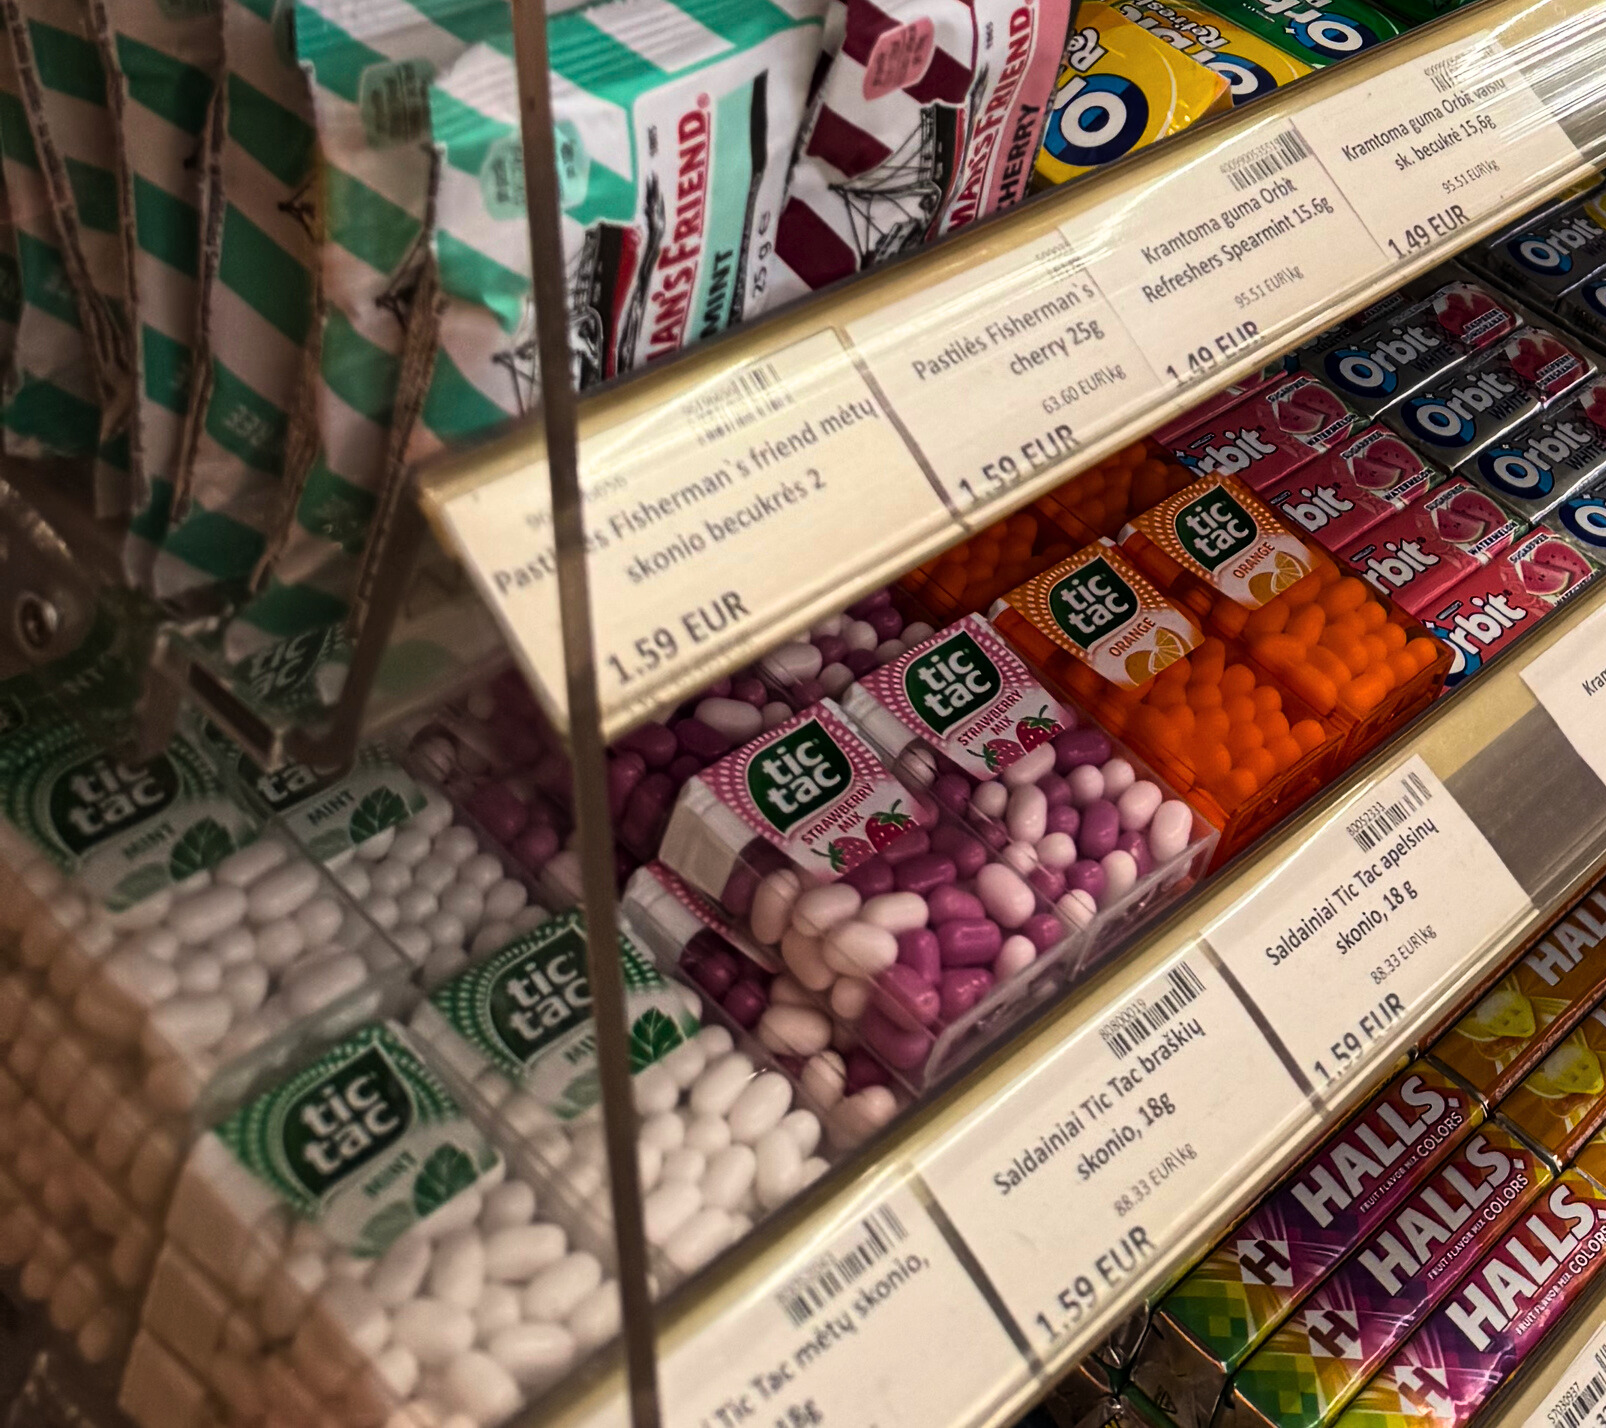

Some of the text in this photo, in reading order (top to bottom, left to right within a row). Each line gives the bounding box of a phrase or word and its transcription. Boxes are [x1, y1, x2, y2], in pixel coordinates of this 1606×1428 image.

[1395, 112, 1497, 172] sk. becukrė 15,6g
[1141, 177, 1298, 266] Kramtoma guma Orbit
[1142, 195, 1335, 305] Refreshers Spearmint 15.6g
[1008, 317, 1106, 378] cherry 25g
[1338, 322, 1441, 386] Orbit
[1418, 367, 1517, 432] Orbit
[1488, 389, 1533, 422] WHITE
[1494, 418, 1592, 483] Orbit
[626, 468, 828, 587] skonio becukrės 2
[1192, 498, 1228, 538] tic
[1192, 515, 1251, 560] tac
[1068, 572, 1108, 612] tic
[1232, 541, 1274, 582] ORANGE
[607, 590, 752, 686] 1.59 EUR
[1066, 590, 1130, 635] tac
[956, 688, 1025, 748] STRAWBERRY
[1264, 815, 1441, 968] Saldainiai Tic Tac apelsinų
[1335, 878, 1419, 956] skonio, 18 g
[992, 1016, 1207, 1197] Saldainiai Tic Tac braškių
[1074, 1090, 1177, 1183] skonio, 18g
[1290, 1073, 1448, 1229] HALLS
[1360, 1109, 1465, 1213] FRUIT FLAVOR MIX COLORS
[1358, 1134, 1514, 1296] HALLS
[1035, 1224, 1158, 1344] 1.59 EUR
[1444, 1182, 1598, 1352] HALLS
